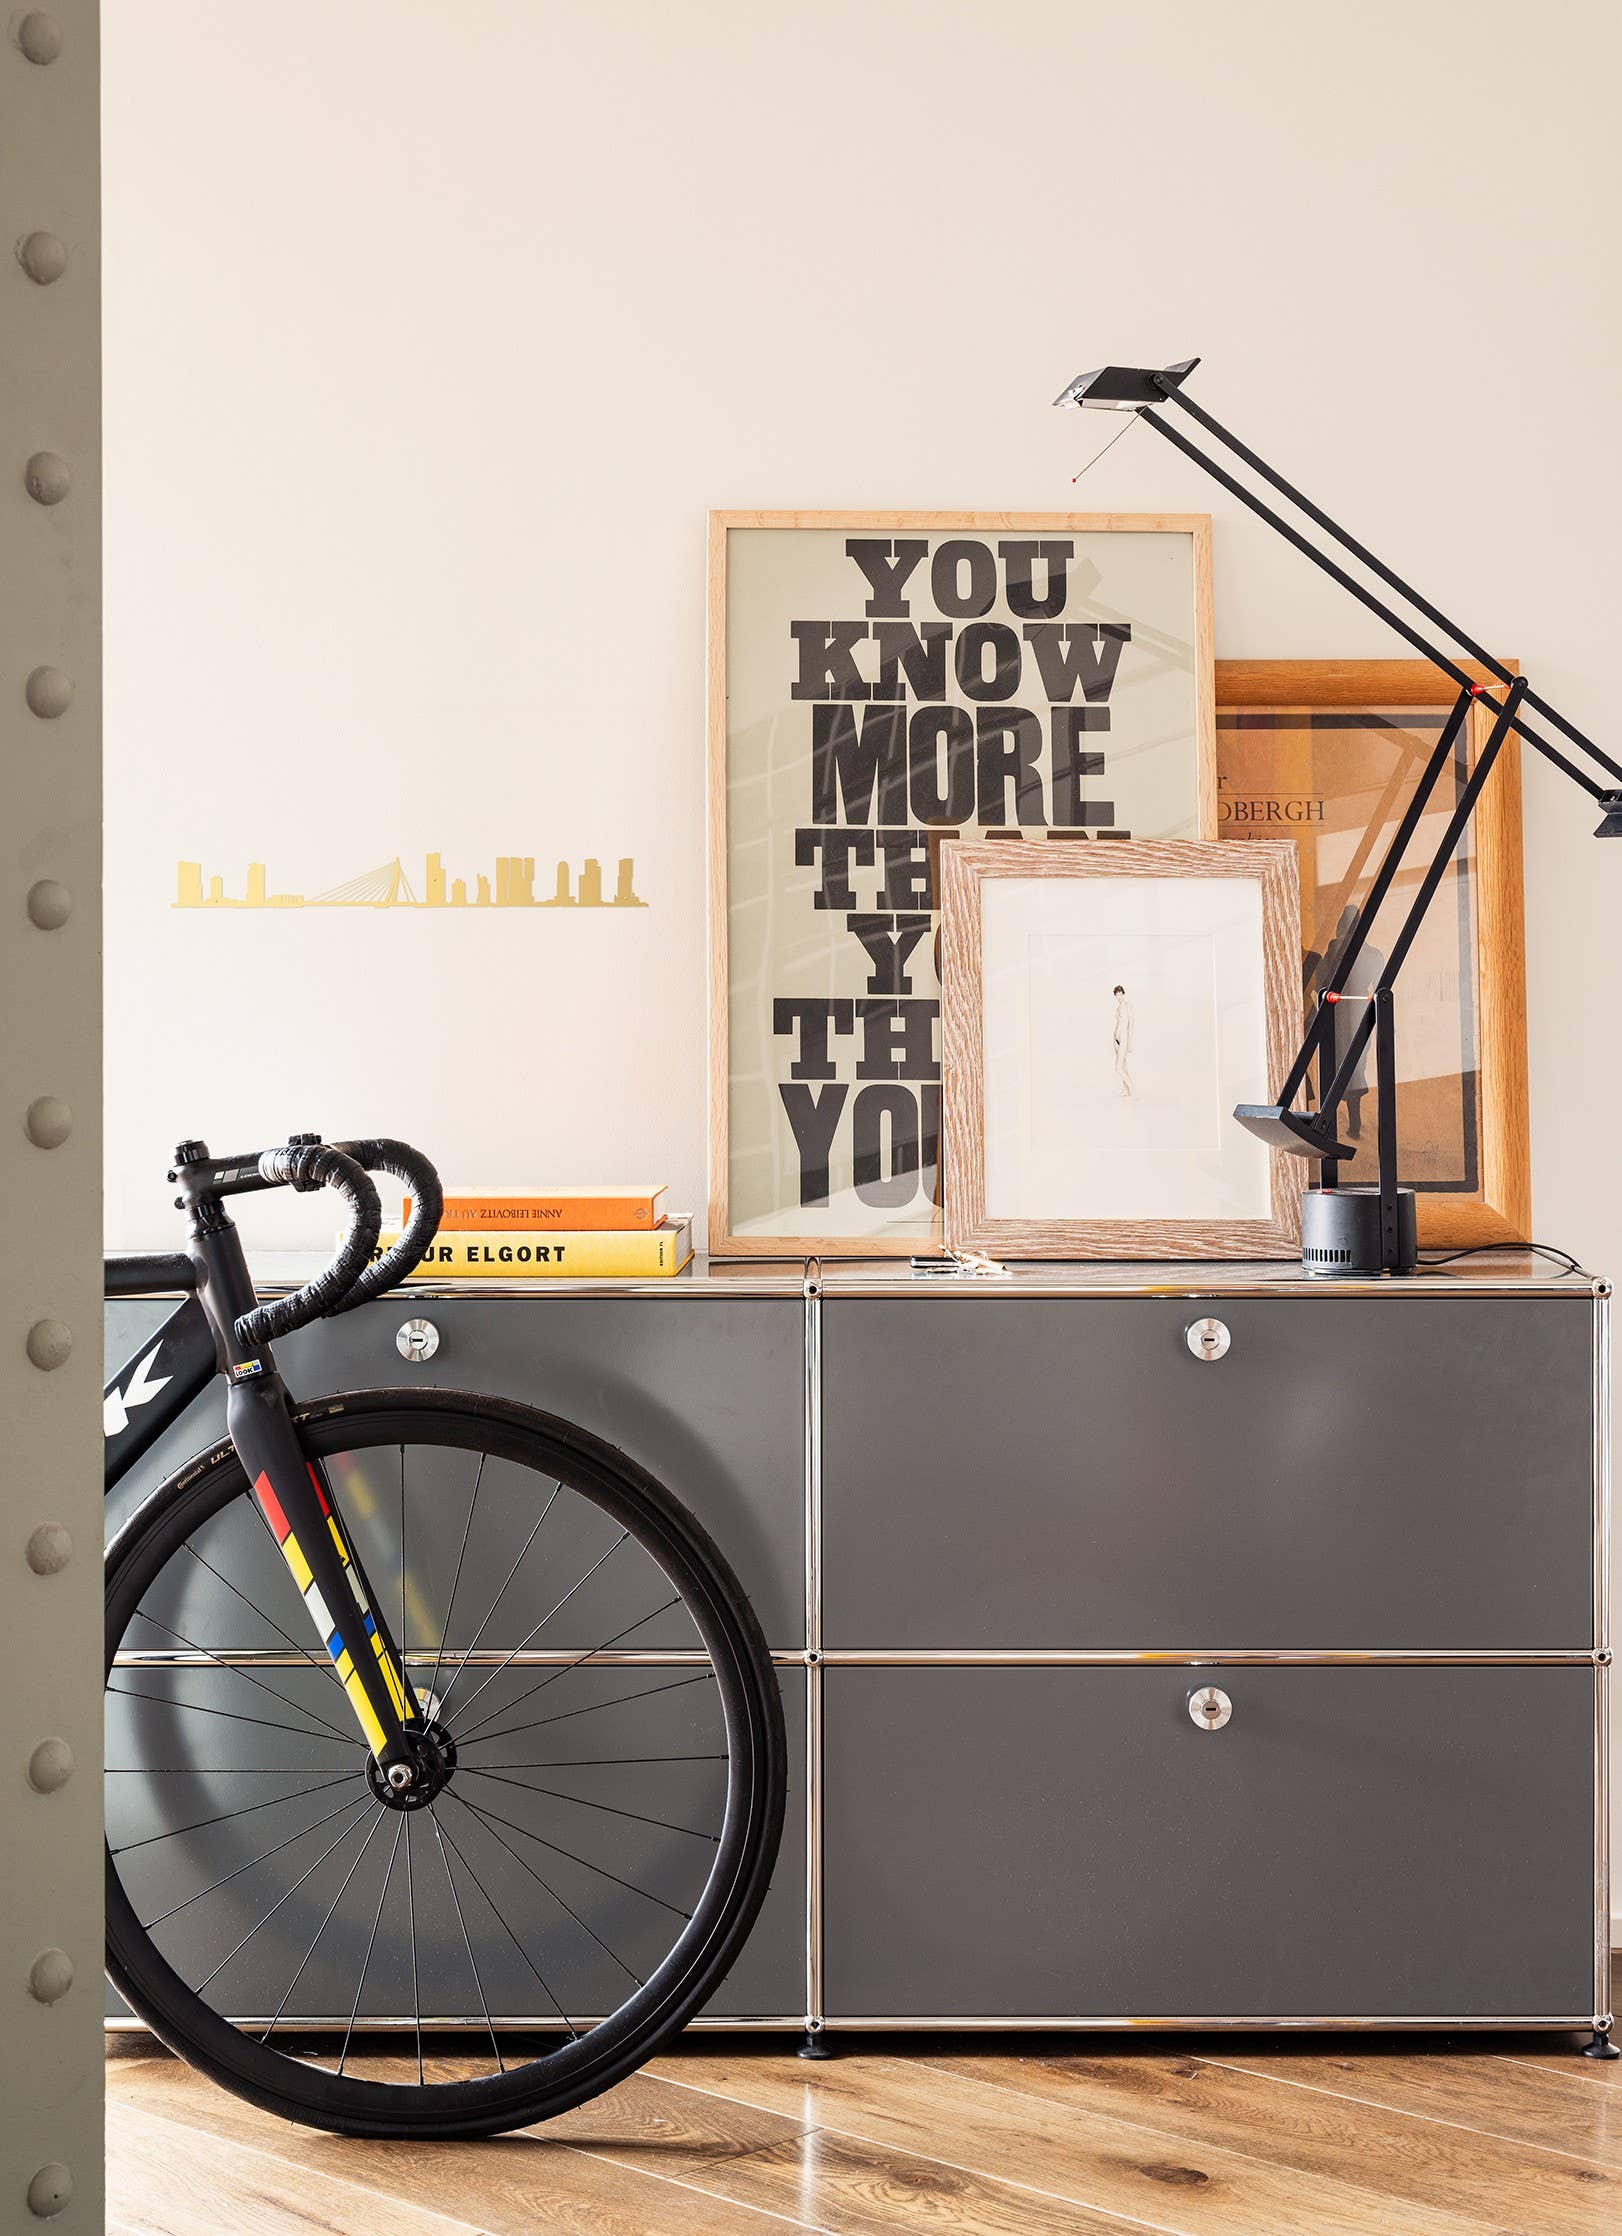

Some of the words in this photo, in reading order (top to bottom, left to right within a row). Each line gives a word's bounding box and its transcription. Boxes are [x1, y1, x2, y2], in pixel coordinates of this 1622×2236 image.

[845, 539, 1075, 620] YOU
[790, 620, 1132, 702] KNOW
[812, 703, 1116, 827] MORE
[847, 913, 943, 995] Y
[773, 998, 942, 1080] TH
[480, 1208, 529, 1219] LEIBOVITZ
[532, 1208, 563, 1219] ANNIE
[467, 1246, 566, 1263] ELGORT
[210, 1444, 235, 1464] ULT
